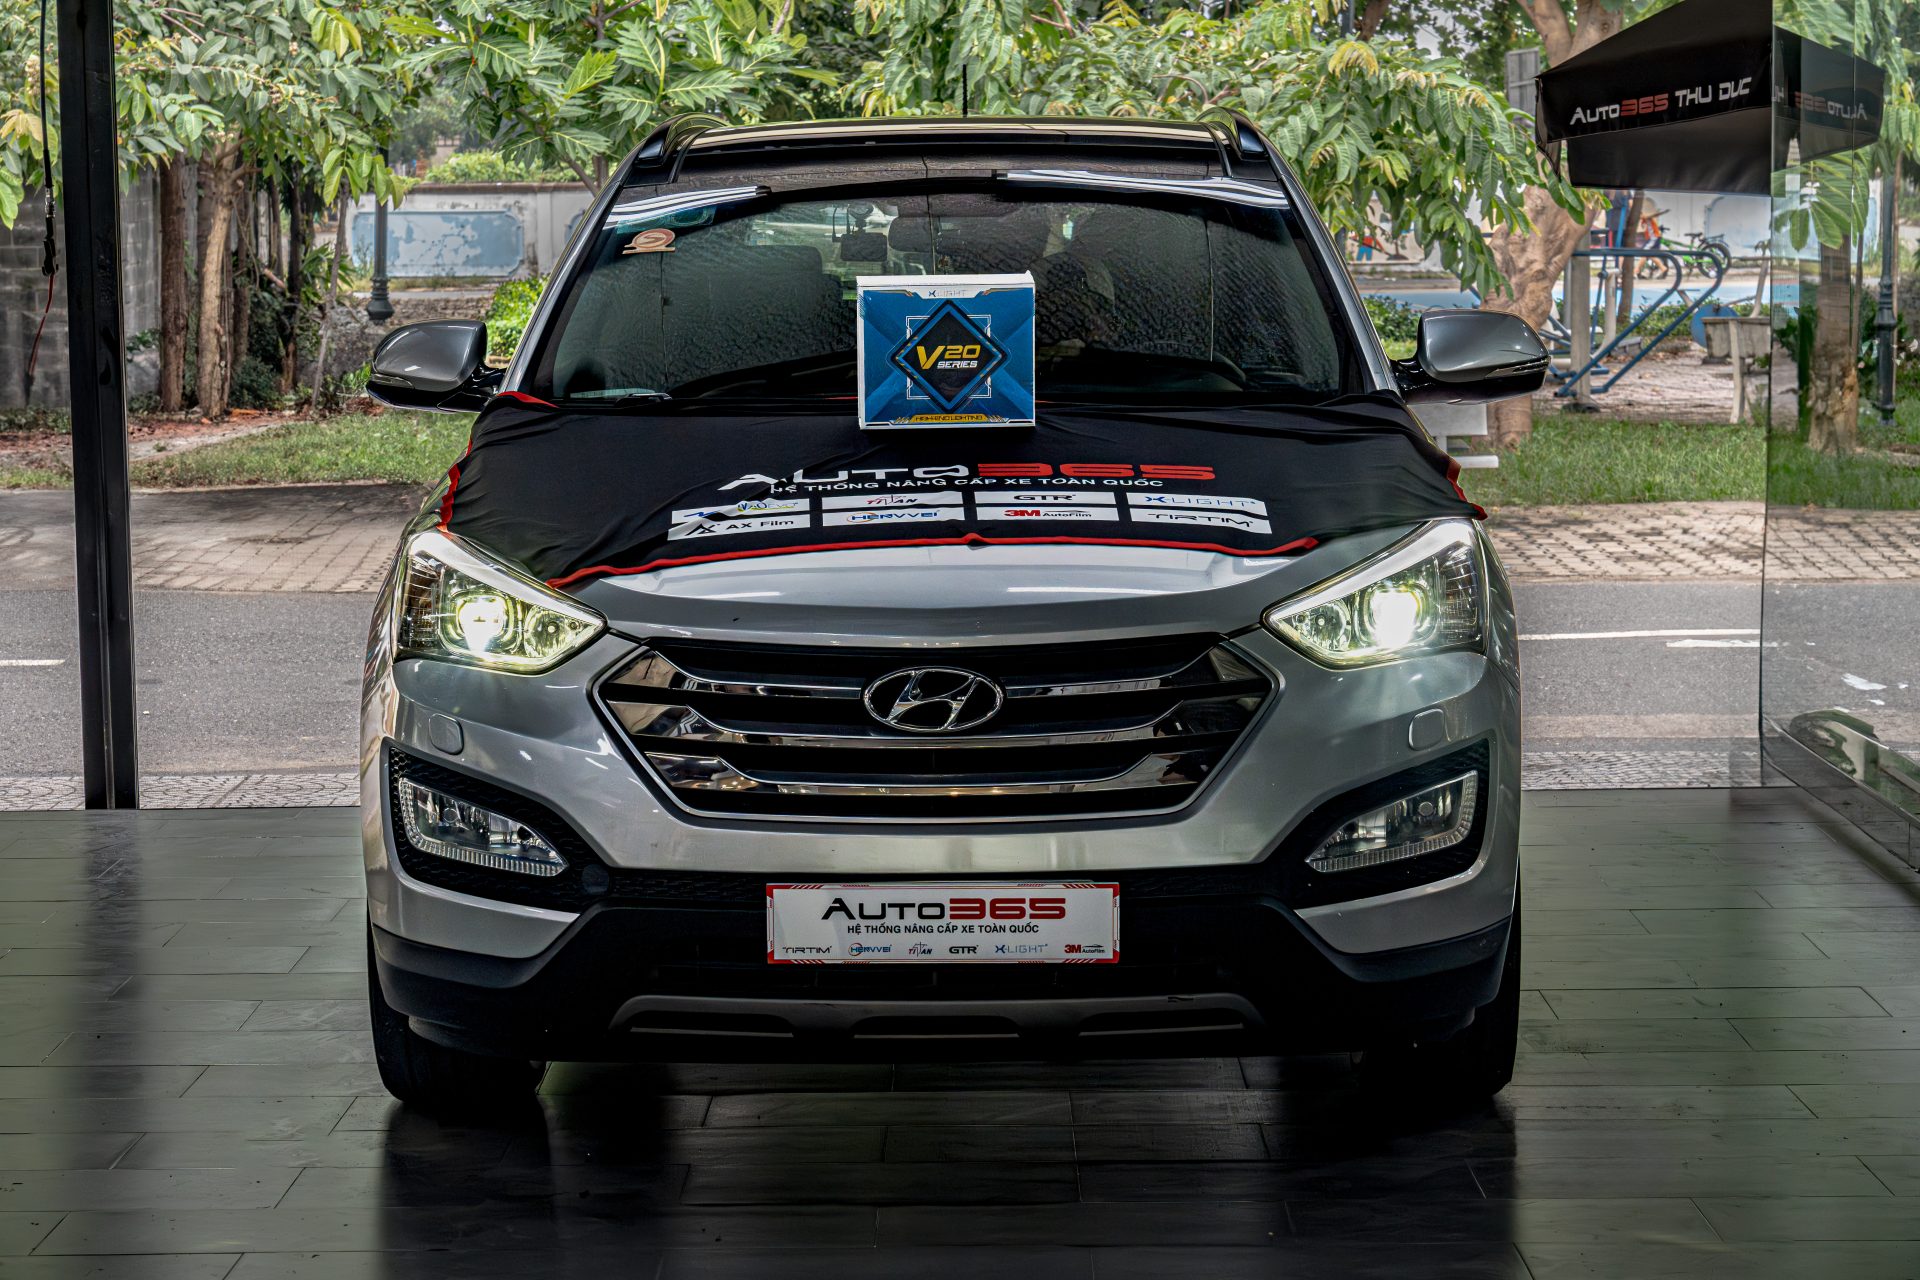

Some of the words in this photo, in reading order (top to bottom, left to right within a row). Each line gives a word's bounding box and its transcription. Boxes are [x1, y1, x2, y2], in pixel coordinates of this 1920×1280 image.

[1569, 93, 1669, 125] AUTO365
[1675, 85, 1712, 108] THU
[937, 360, 978, 369] SERIES
[1004, 509, 1041, 517] 3M
[726, 523, 752, 531] AX
[760, 520, 794, 528] Film
[821, 898, 1066, 920] AUTO365
[847, 923, 862, 934] HỆ
[864, 921, 901, 934] THỐNG
[904, 922, 934, 934] NÂNG
[937, 921, 958, 934] CẤP
[961, 924, 975, 934] XE
[978, 922, 1006, 934] TOÀN
[1009, 921, 1040, 934] QUỐC
[949, 946, 977, 954] GTR
[1064, 944, 1082, 954] 3M
